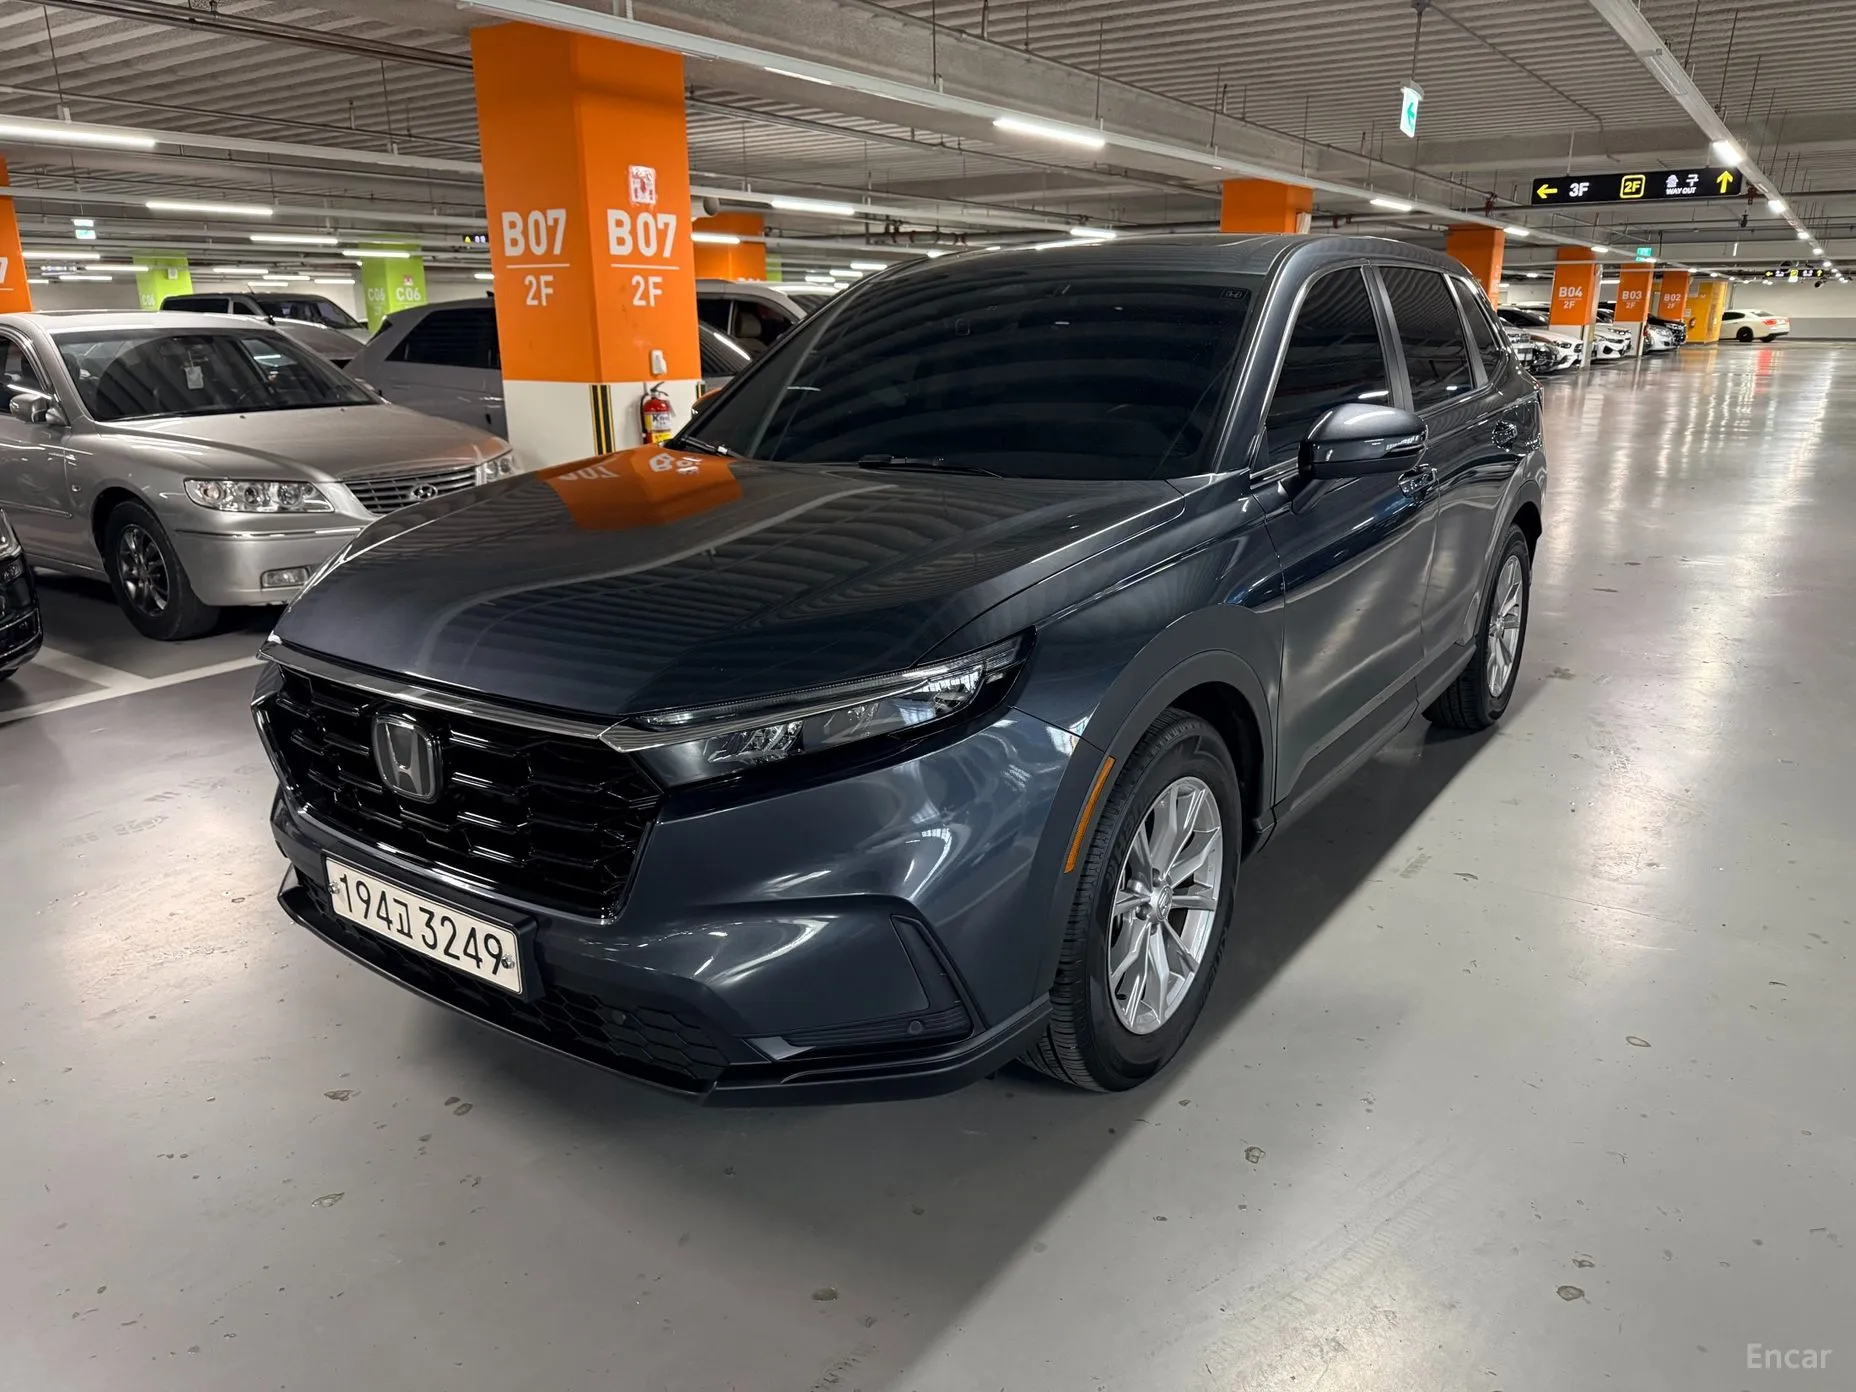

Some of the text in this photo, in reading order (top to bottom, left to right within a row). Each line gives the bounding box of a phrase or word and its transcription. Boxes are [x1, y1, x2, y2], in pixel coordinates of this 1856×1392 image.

[1569, 182, 1590, 197] 3F
[1623, 180, 1641, 193] 2F
[1665, 187, 1682, 195] WAY
[502, 208, 566, 257] B07
[607, 208, 677, 258] B07
[396, 287, 422, 301] C06
[524, 274, 554, 307] 2F
[631, 274, 663, 307] 2F
[1558, 286, 1583, 298] B04
[1621, 290, 1643, 300] B03
[1663, 293, 1682, 302] B02
[1563, 300, 1576, 309] 2F
[1626, 301, 1636, 309] 2F
